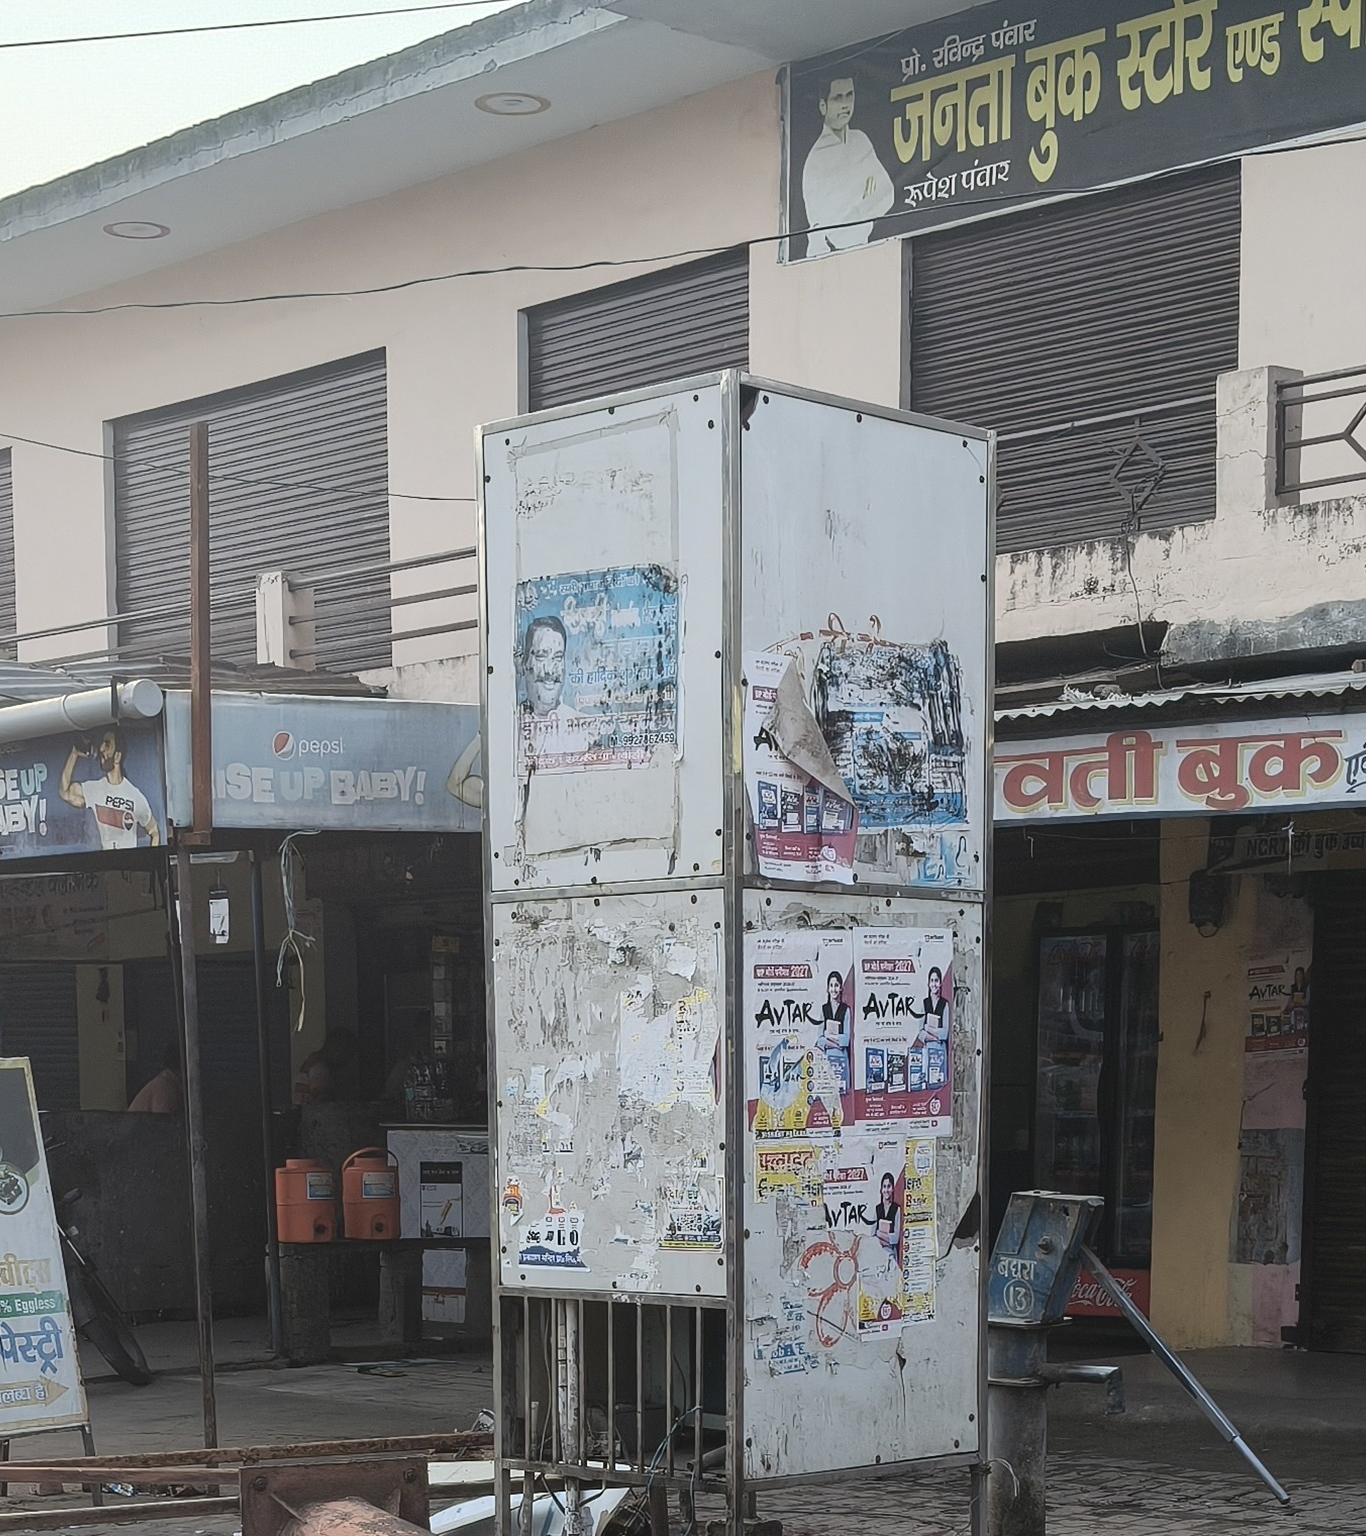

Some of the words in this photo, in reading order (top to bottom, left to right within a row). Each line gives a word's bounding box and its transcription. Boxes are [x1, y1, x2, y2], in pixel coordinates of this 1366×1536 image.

[932, 33, 986, 69] रविन्द्र
[991, 18, 1038, 50] पंवार
[890, 54, 1017, 165] जनता
[1025, 27, 1108, 183] बुक
[1226, 12, 1285, 83] एण्ड
[904, 171, 957, 207] रूपेश
[961, 159, 1012, 193] पंवार
[298, 736, 345, 758] pepsi
[19, 763, 48, 796] UP
[212, 762, 276, 803] ISE
[280, 767, 326, 801] UP
[330, 766, 427, 806] BABY!
[1176, 730, 1345, 811] बुक
[790, 965, 809, 978] 2027
[895, 960, 912, 972] 2027
[997, 1256, 1037, 1281] बघरा
[14, 1297, 57, 1314] Eggless
